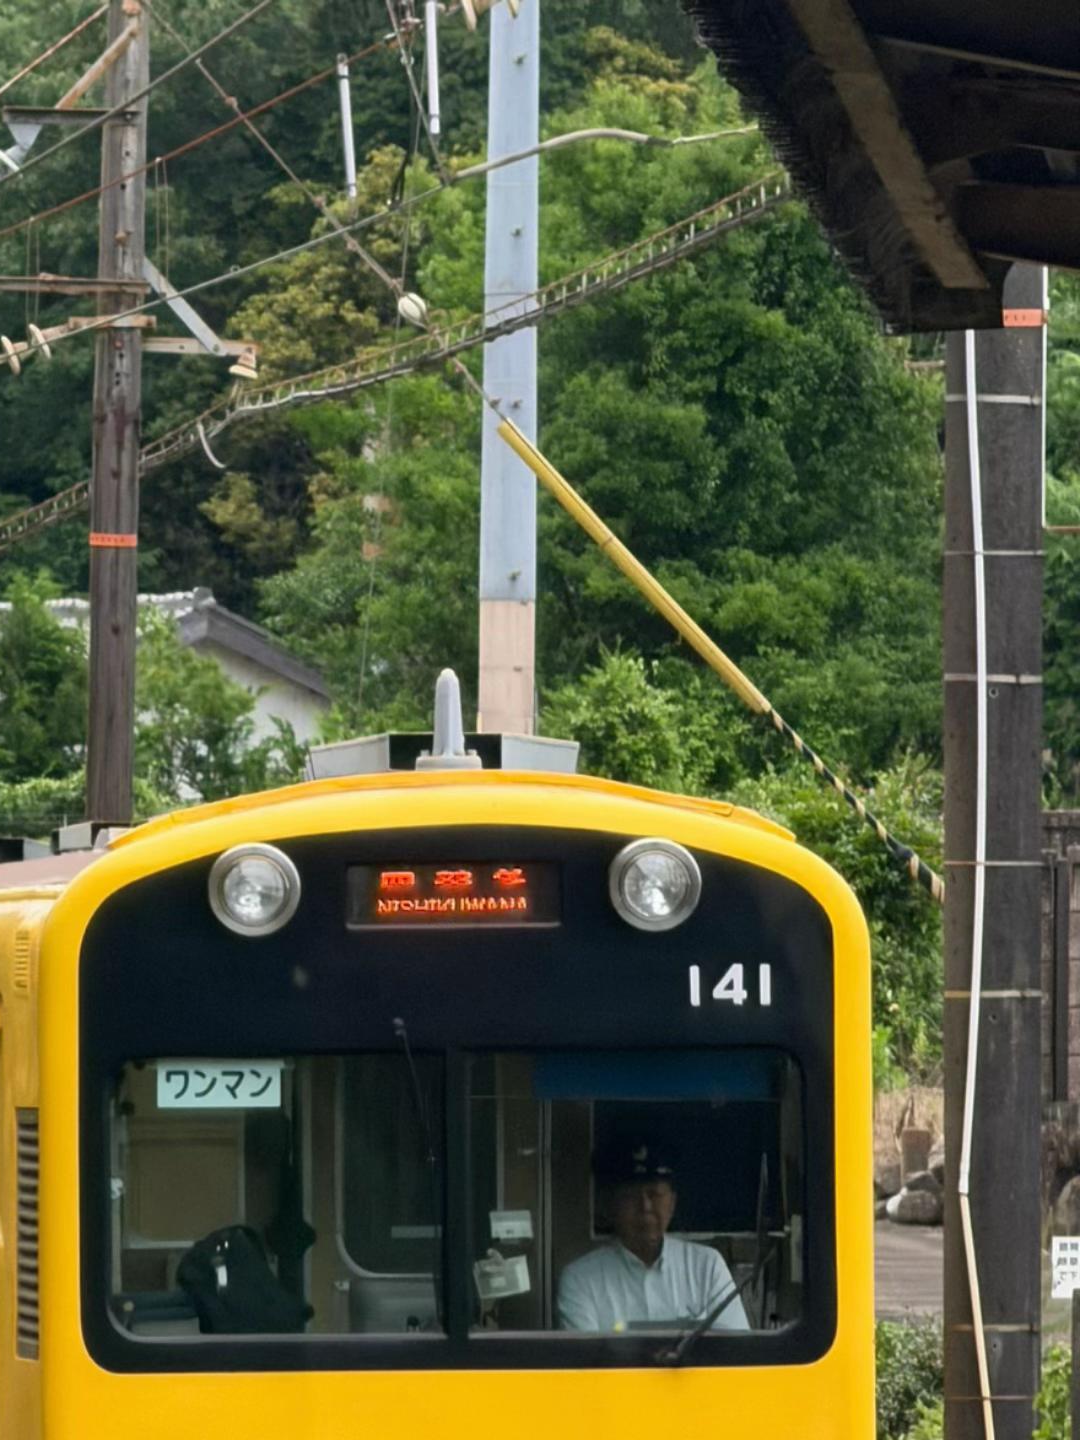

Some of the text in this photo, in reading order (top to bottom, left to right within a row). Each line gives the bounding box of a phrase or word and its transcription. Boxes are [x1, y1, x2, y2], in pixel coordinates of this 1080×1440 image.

[689, 962, 772, 1007] 141
[165, 1069, 273, 1100] ワンマン
